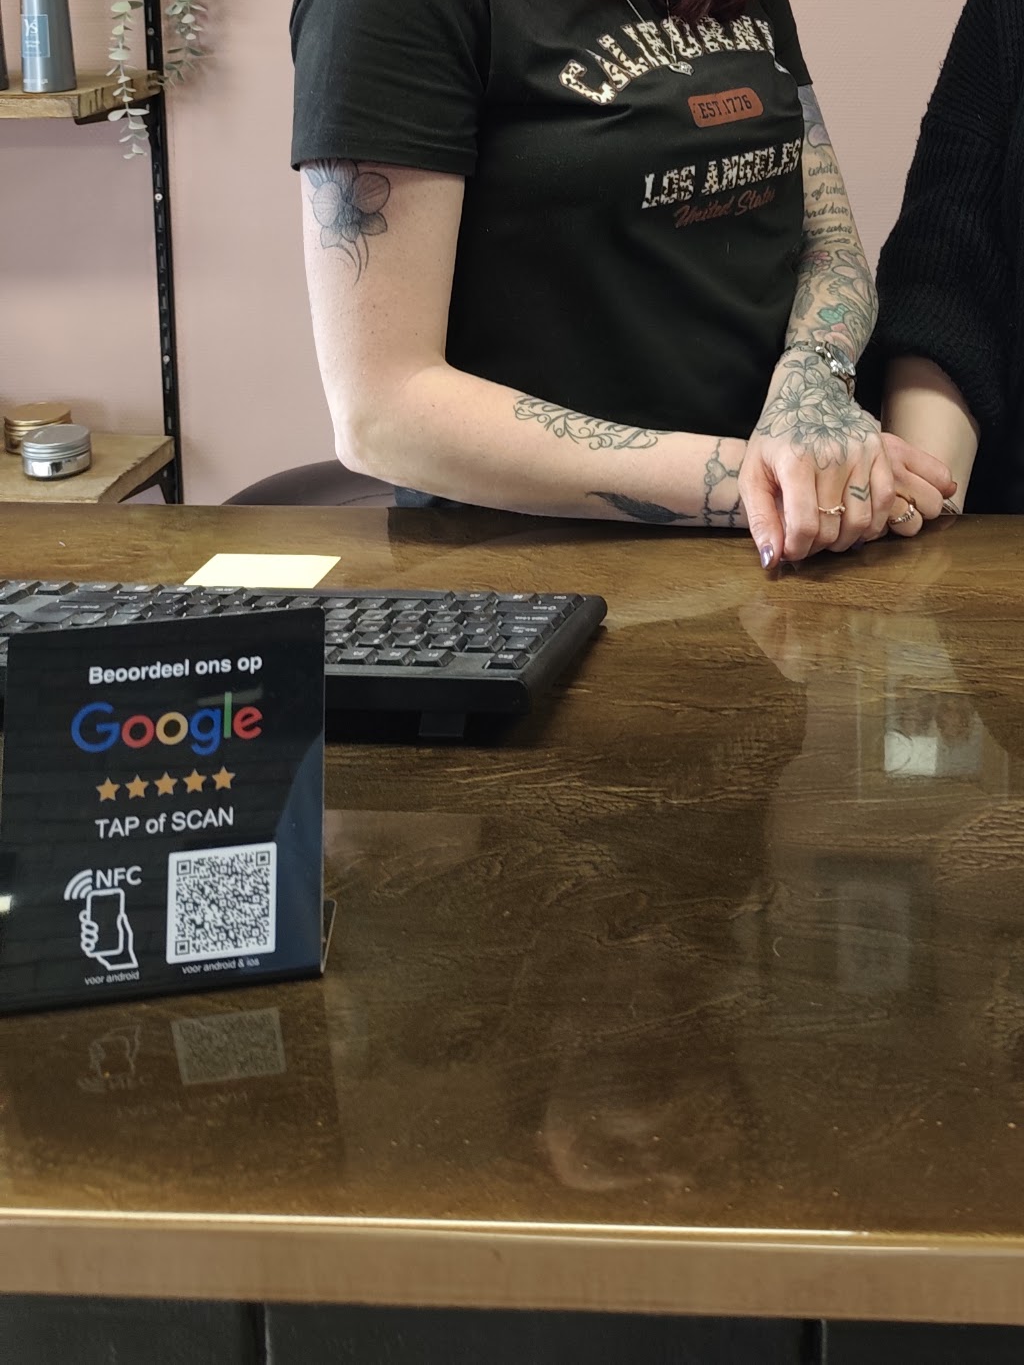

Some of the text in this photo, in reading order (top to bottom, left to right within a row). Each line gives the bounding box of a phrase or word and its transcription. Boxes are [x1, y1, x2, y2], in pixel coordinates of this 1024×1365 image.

[641, 165, 696, 209] LOS
[88, 655, 263, 684] Beoordeel ons op
[71, 691, 264, 756] Google
[94, 806, 234, 839] TAP of SCAN
[96, 865, 142, 888] NFC
[84, 970, 140, 985] voor android
[182, 965, 202, 974] voor
[203, 959, 237, 972] android
[238, 958, 245, 968] &
